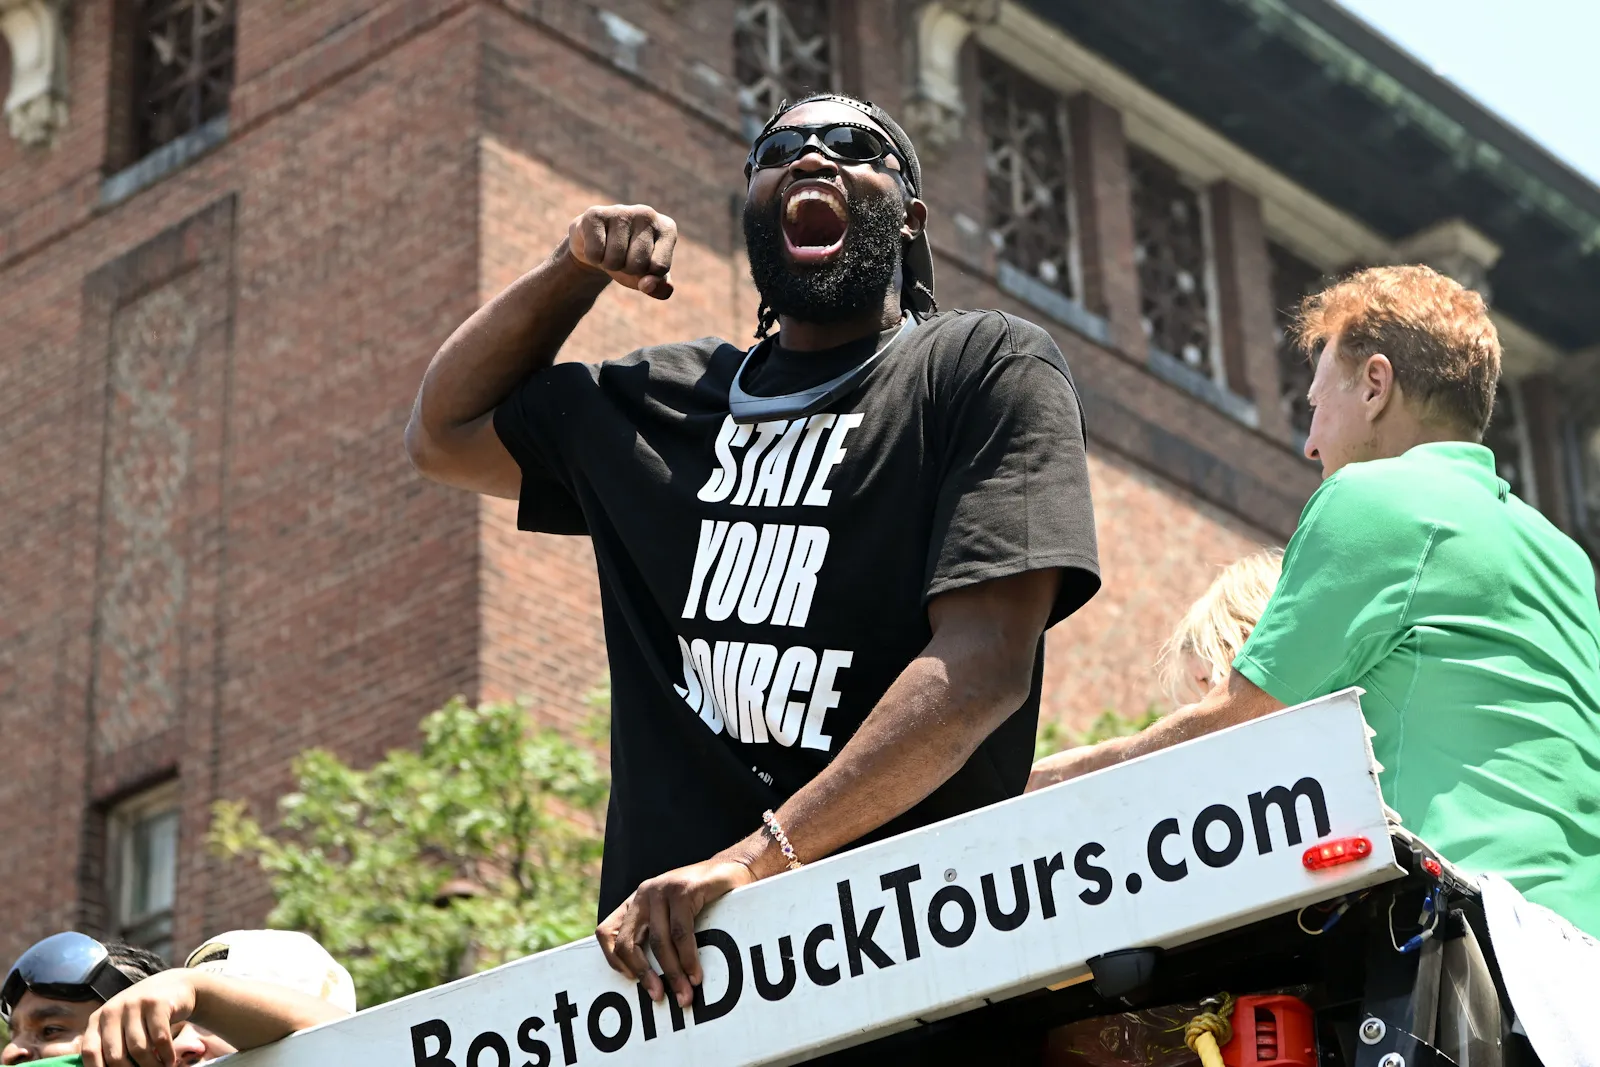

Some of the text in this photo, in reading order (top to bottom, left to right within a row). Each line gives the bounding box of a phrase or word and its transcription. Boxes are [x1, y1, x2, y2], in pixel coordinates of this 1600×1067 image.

[697, 413, 865, 507] STATE
[681, 519, 830, 628] YOUR
[673, 635, 854, 752] SOURCE
[410, 776, 1332, 1067] BostonDuckTours.com
